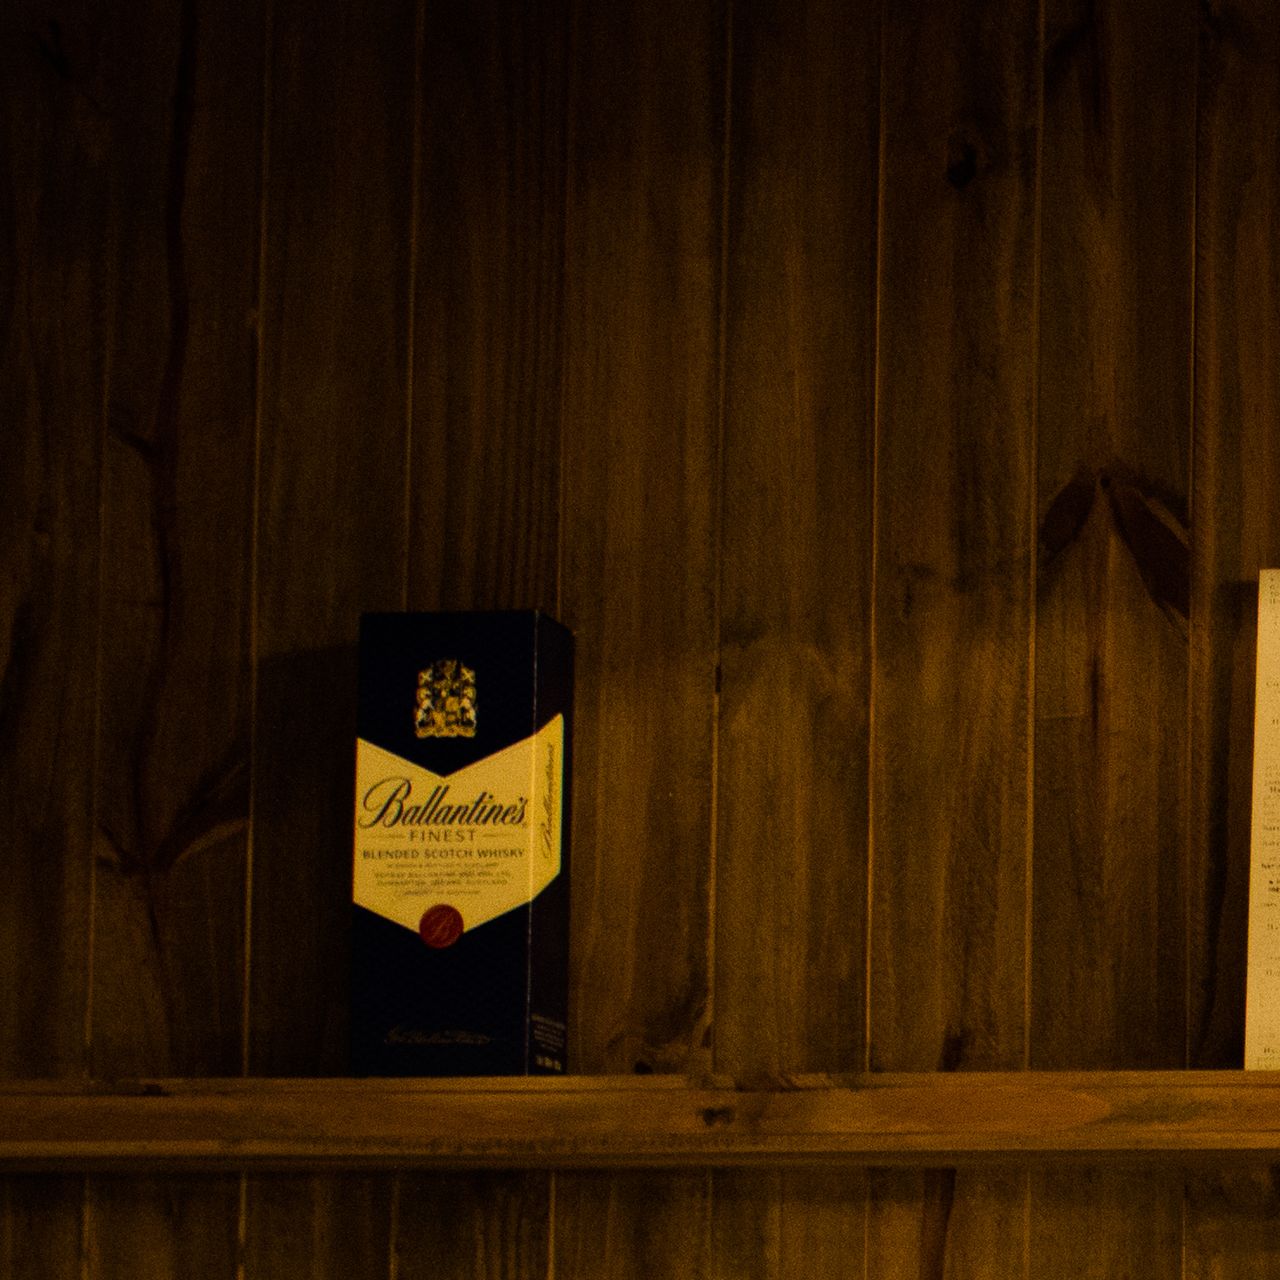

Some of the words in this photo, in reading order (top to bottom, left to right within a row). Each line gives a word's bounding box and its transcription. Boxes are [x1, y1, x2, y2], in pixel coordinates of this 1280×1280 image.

[358, 776, 528, 829] Ballantine's
[409, 829, 477, 843] FINEST
[362, 849, 420, 860] BLENDED
[424, 849, 474, 860] SCOTCH
[476, 848, 526, 859] WHISKY
